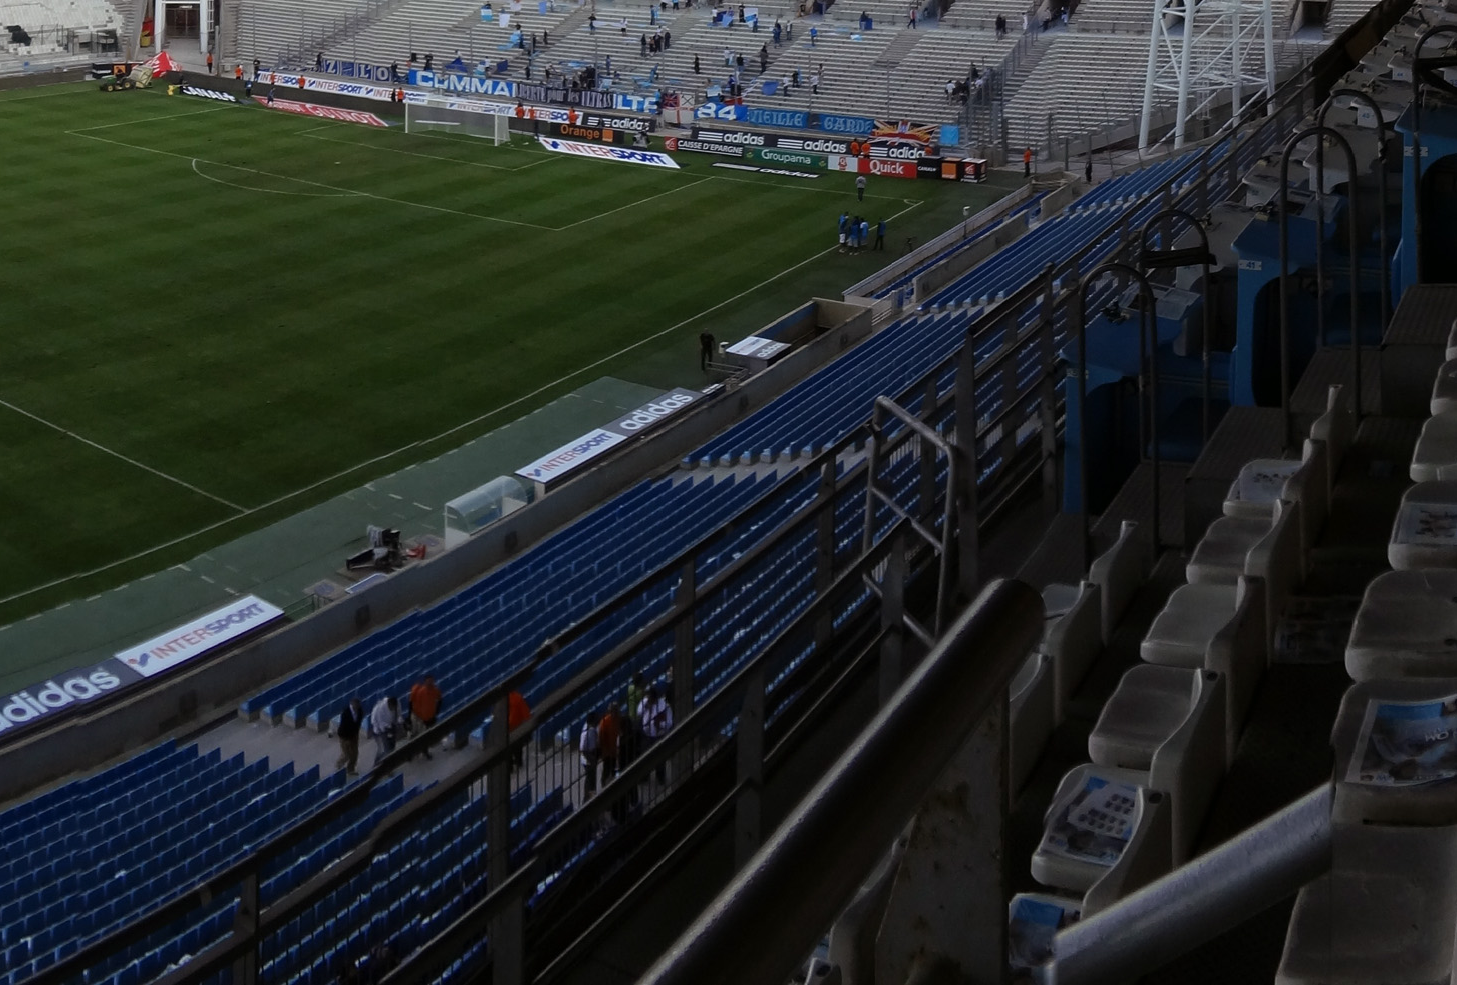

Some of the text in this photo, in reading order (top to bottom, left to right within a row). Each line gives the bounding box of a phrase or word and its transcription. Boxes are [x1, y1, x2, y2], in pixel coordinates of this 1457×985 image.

[315, 81, 363, 94] INTERSPORT
[697, 102, 736, 120] 84
[560, 124, 600, 140] Orange
[724, 132, 764, 146] adidas
[678, 140, 702, 149] CAISSE
[804, 139, 846, 154] adidas
[889, 145, 926, 159] adida
[560, 141, 667, 166] INTERSPORT
[761, 149, 811, 165] Groupama
[869, 159, 904, 175] Quick
[620, 393, 693, 430] adidas
[541, 432, 612, 472] INTERSPORT
[150, 602, 265, 659] INTERSPORT
